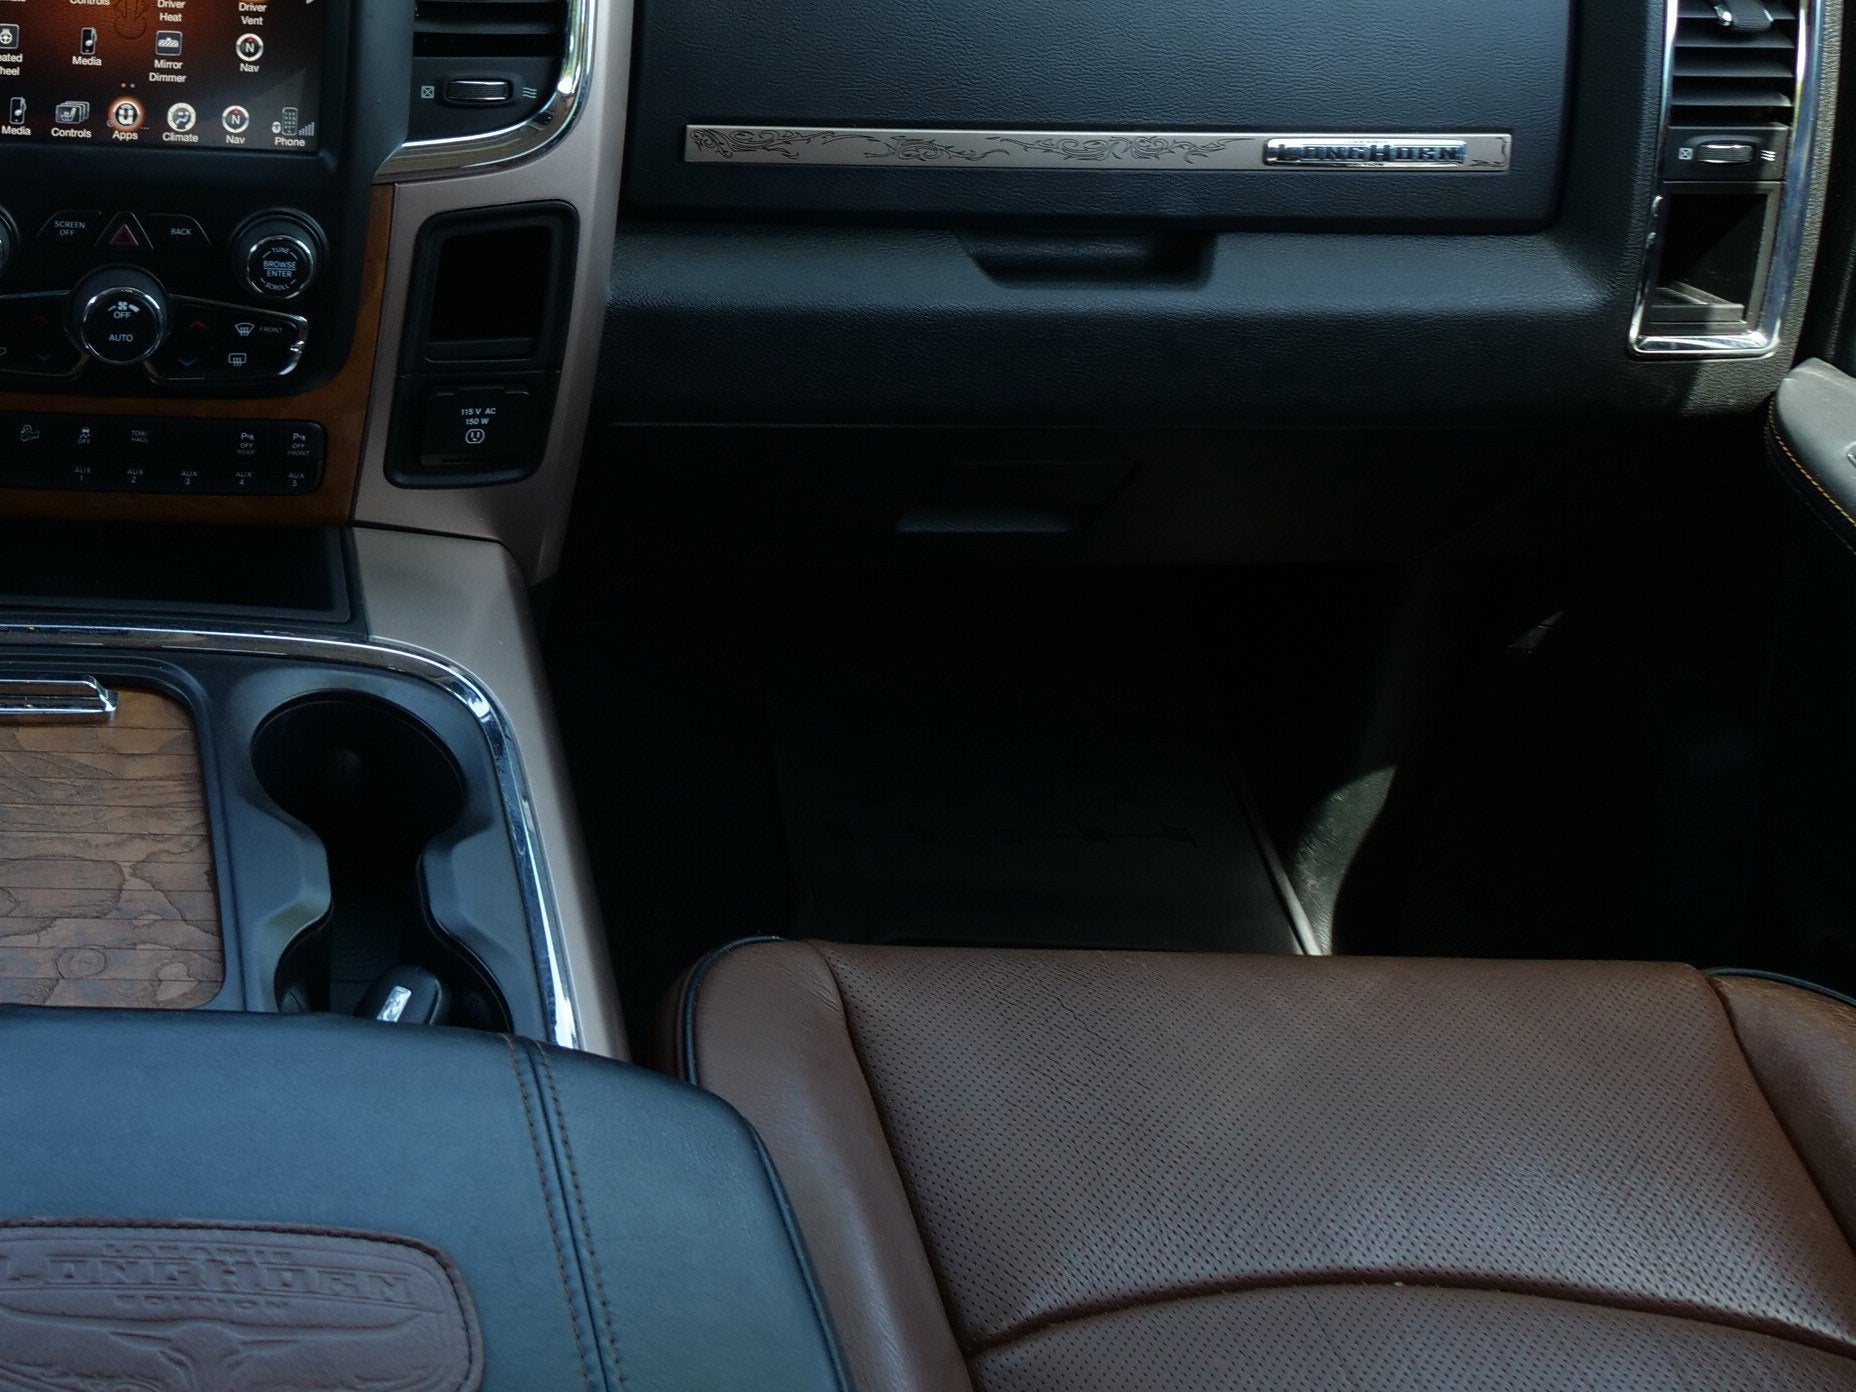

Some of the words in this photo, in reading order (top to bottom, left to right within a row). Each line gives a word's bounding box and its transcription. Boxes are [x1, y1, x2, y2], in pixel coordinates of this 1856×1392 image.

[157, 0, 186, 9] Driver
[238, 2, 267, 13] Driver
[159, 13, 182, 22] Heat
[241, 16, 263, 26] Vent
[72, 56, 102, 66] Media
[154, 60, 184, 70] Mirror
[240, 64, 260, 73] Nav
[149, 73, 187, 83] Dimmer
[1, 126, 31, 136] Media
[51, 128, 92, 138] Controls
[112, 131, 138, 141] Apps
[162, 132, 199, 143] Climate
[226, 135, 245, 144] Nav
[274, 137, 306, 147] Phone
[54, 220, 86, 229] SCREEN
[59, 229, 75, 237] OFF
[170, 228, 192, 236] BACK
[263, 260, 297, 269] BROWSE
[266, 270, 293, 278] ENTER
[259, 326, 283, 334] FRONT
[108, 334, 134, 342] AUTO
[74, 466, 92, 474] AUX
